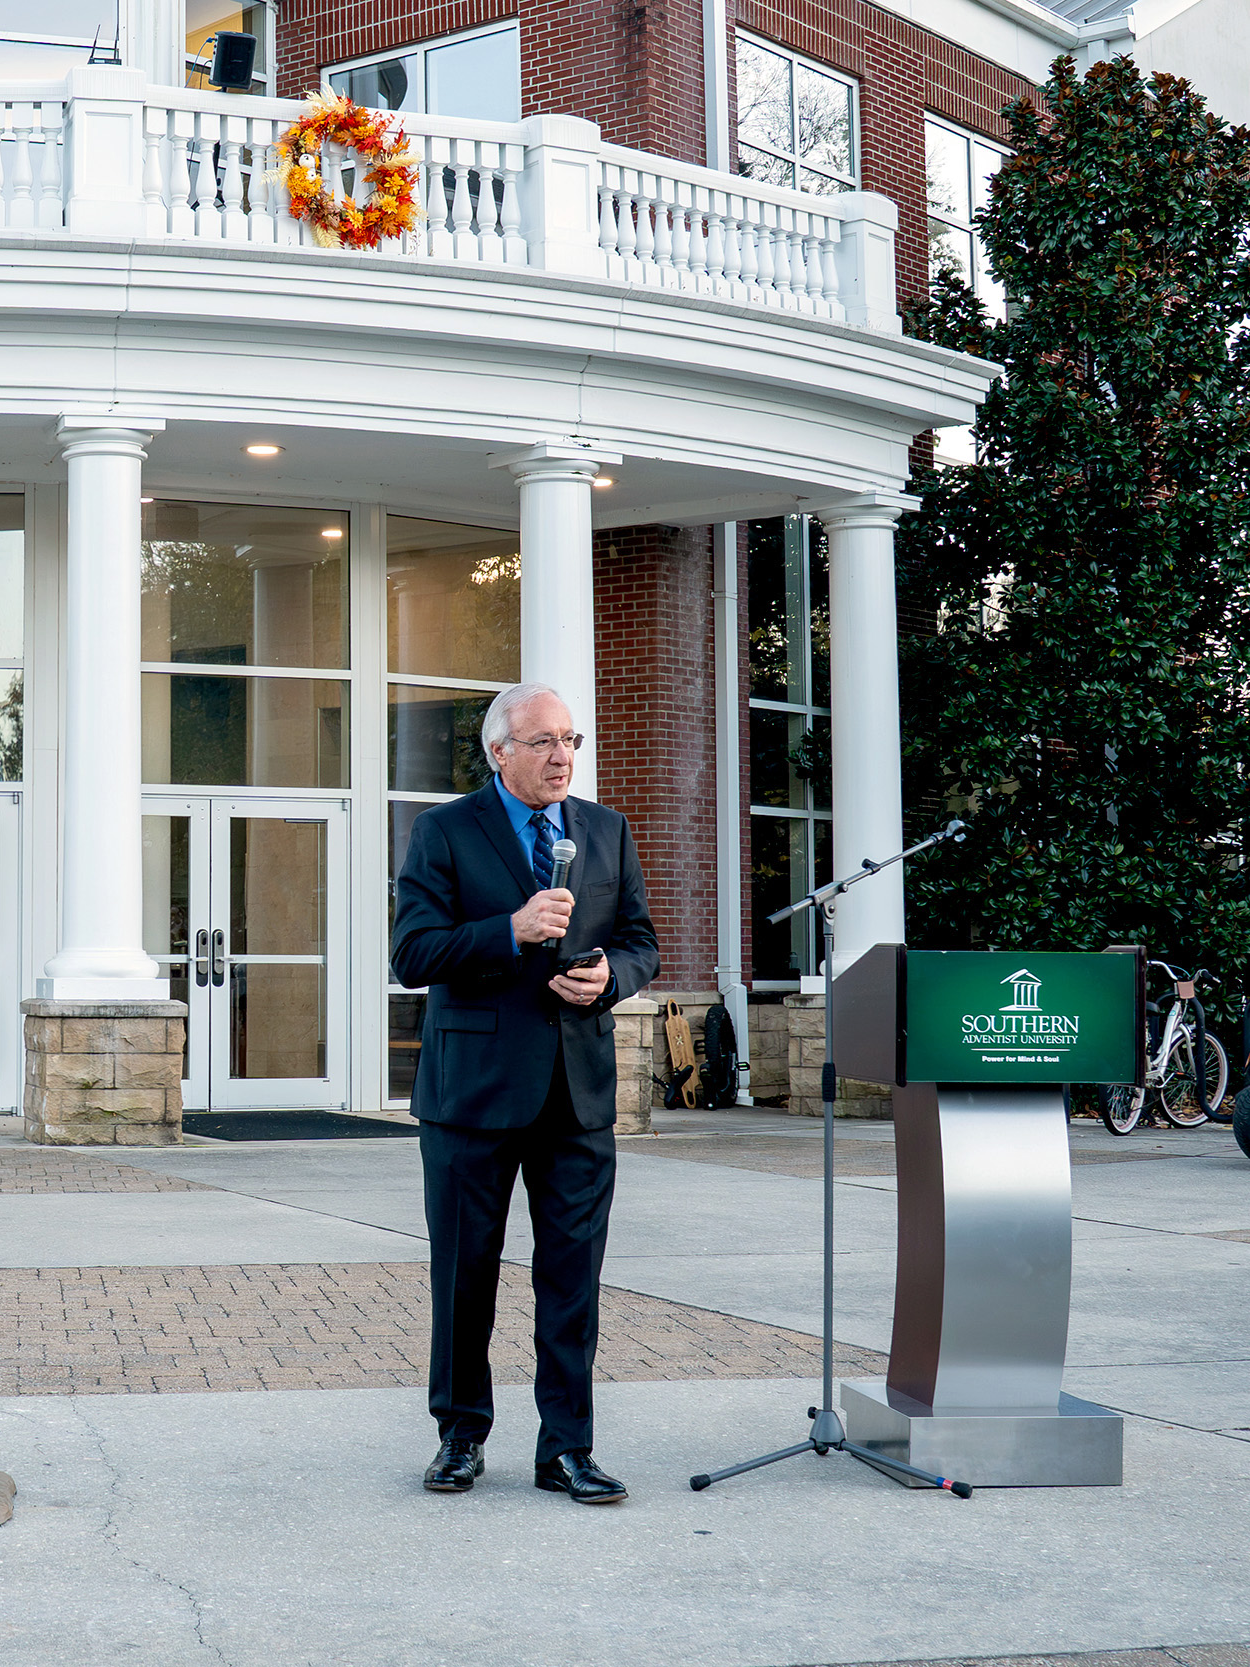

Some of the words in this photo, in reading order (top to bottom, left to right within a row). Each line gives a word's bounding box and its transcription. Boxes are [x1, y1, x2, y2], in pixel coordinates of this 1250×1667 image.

[961, 1014, 1080, 1034] SOUTHERN
[961, 1034, 1018, 1044] ADVENTIST
[1020, 1035, 1078, 1045] UNIVERSITY
[981, 1055, 1005, 1063] Power
[1005, 1055, 1017, 1063] for
[1017, 1055, 1036, 1063] Mind
[1043, 1055, 1060, 1063] Soul
